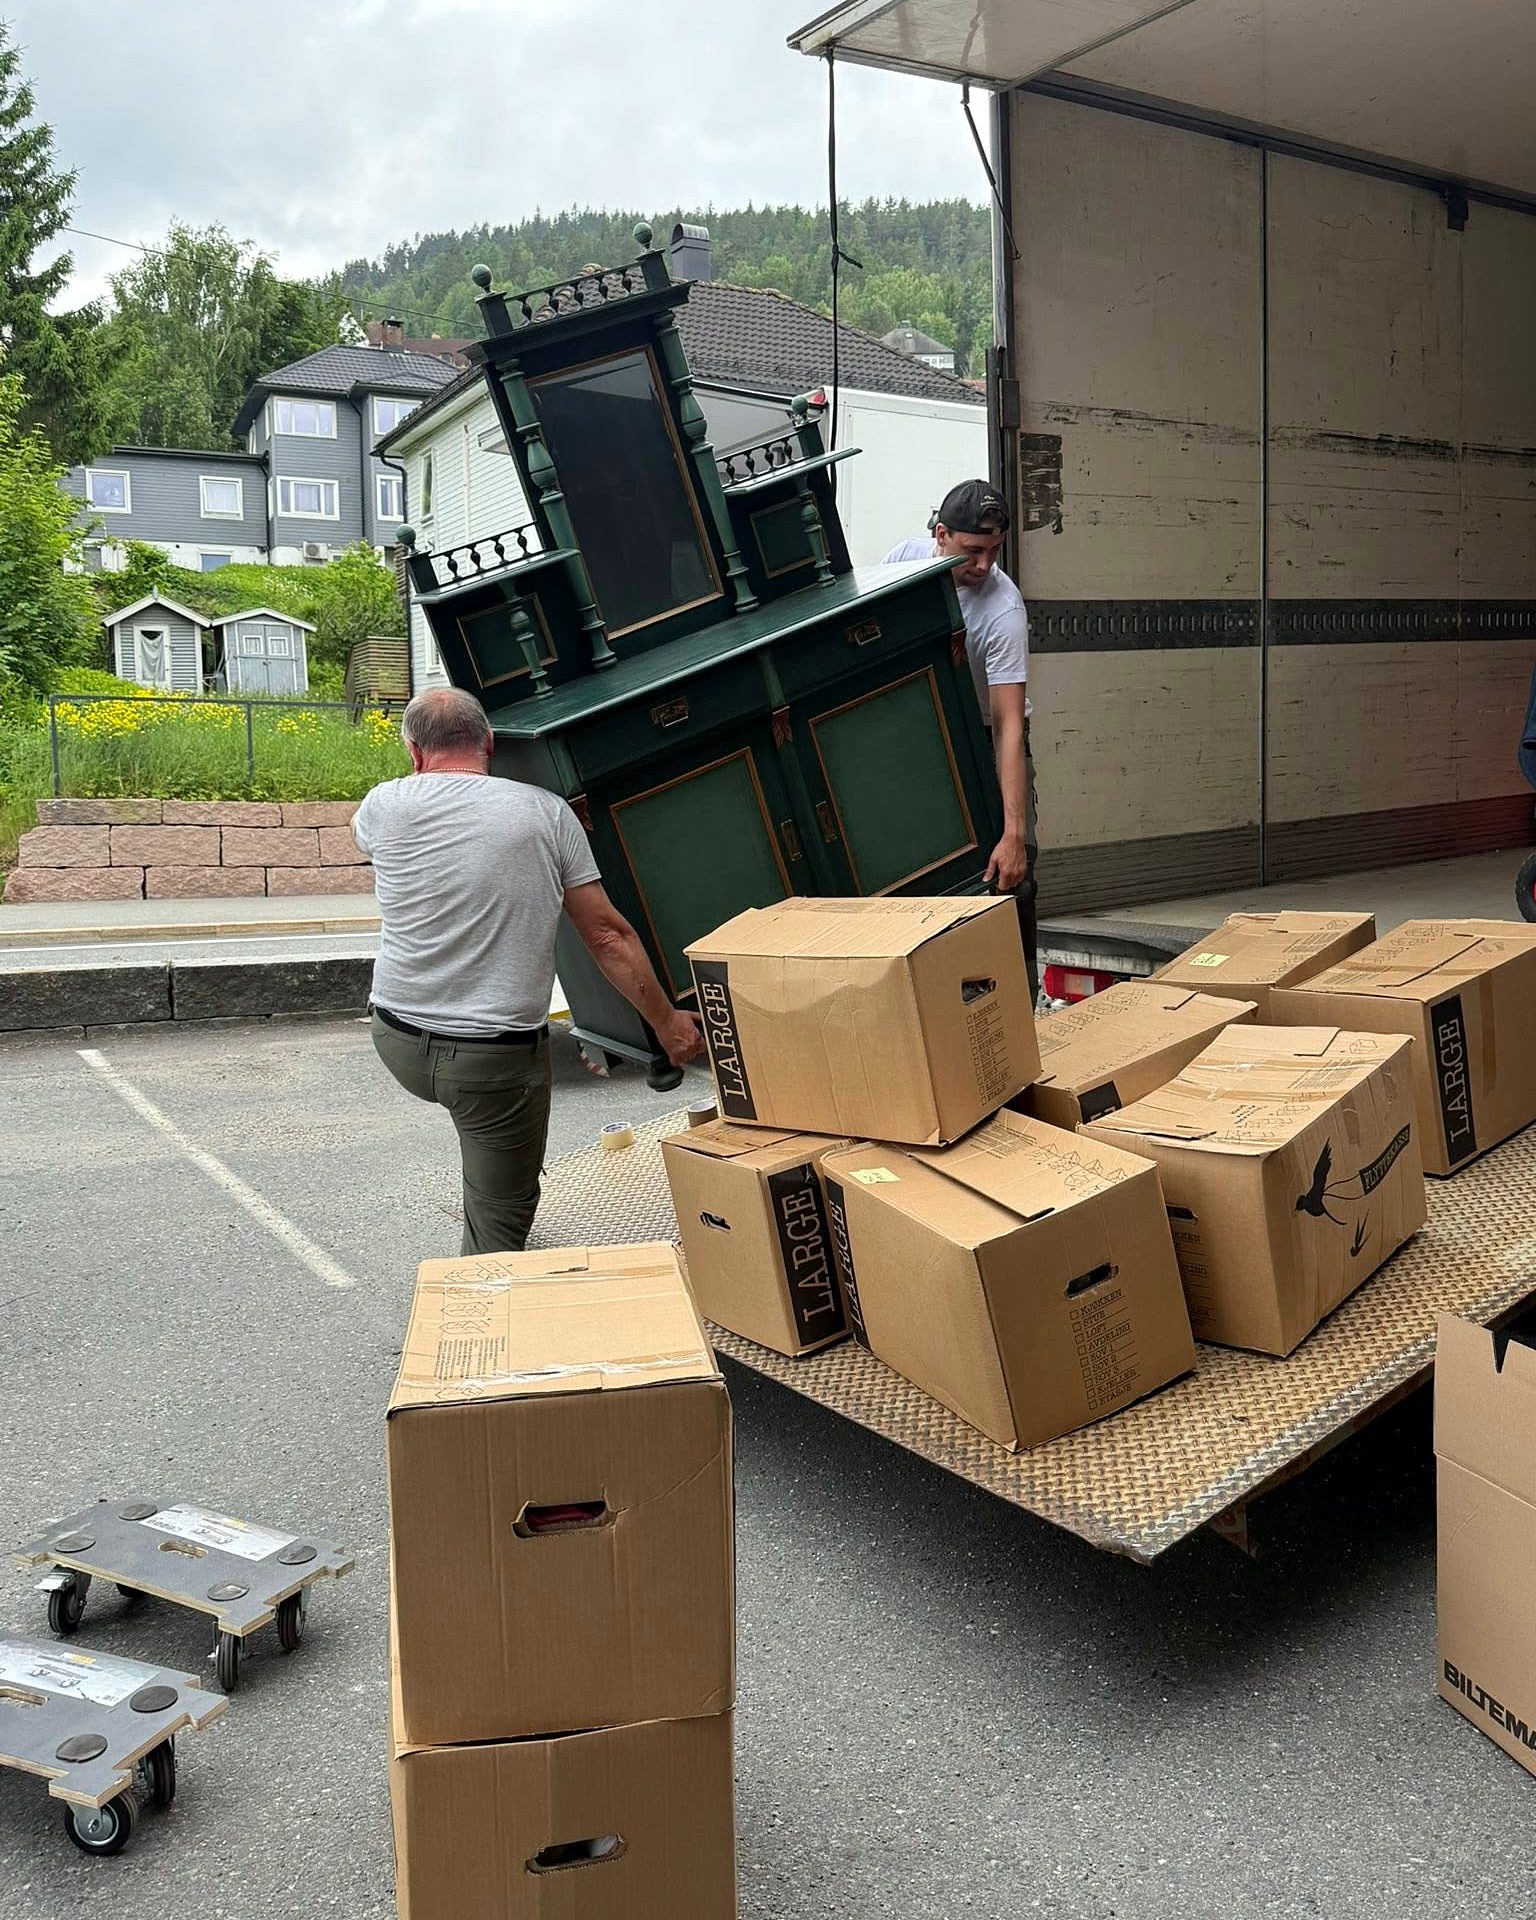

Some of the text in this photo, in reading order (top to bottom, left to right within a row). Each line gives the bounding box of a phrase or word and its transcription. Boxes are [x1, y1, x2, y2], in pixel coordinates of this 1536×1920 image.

[701, 983, 748, 1100] LARGE
[1438, 1018, 1471, 1143] LARGE
[781, 1188, 836, 1322] LARGE
[1088, 1322, 1130, 1351] AVDELING
[1097, 1368, 1136, 1395] KJELLER
